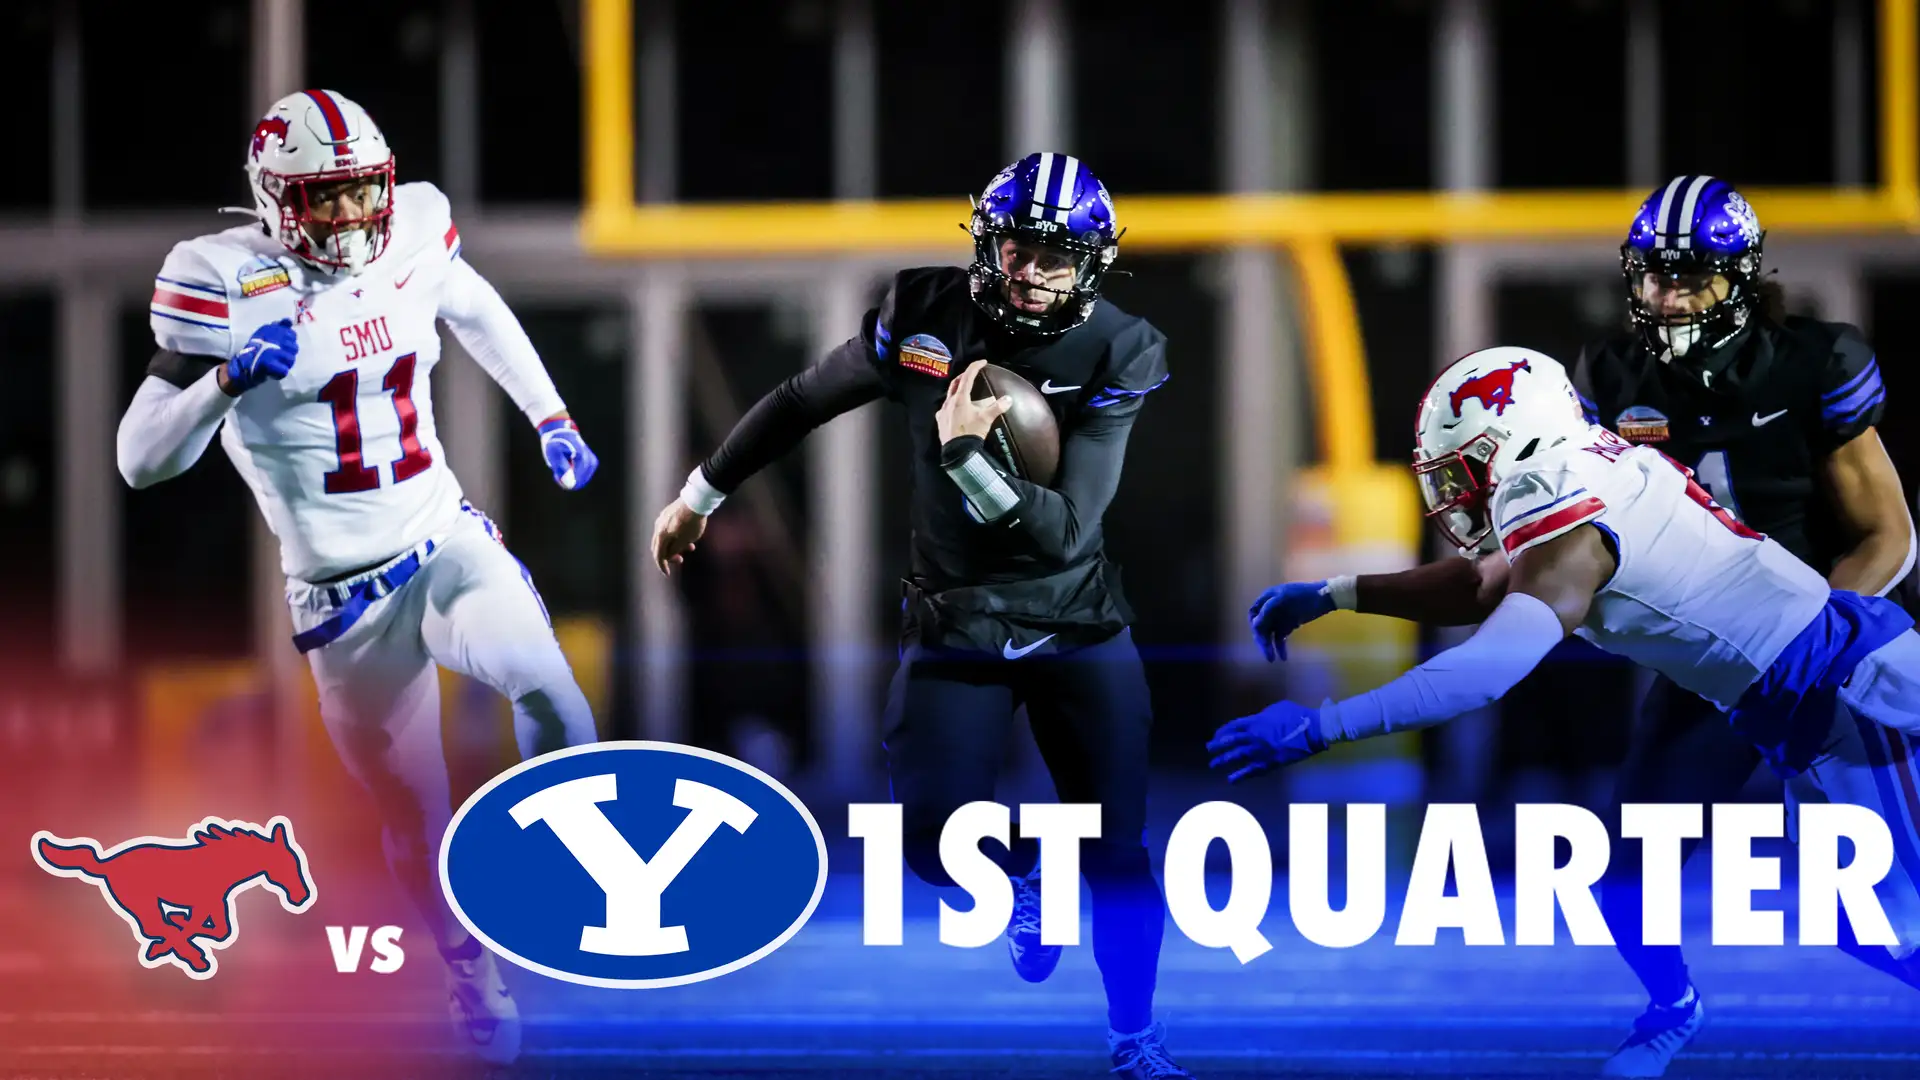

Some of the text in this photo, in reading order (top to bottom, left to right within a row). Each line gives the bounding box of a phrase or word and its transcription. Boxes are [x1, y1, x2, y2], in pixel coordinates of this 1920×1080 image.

[1035, 220, 1058, 232] BYU
[1660, 249, 1680, 260] BYU
[340, 316, 393, 362] SMU
[317, 352, 433, 494] 11
